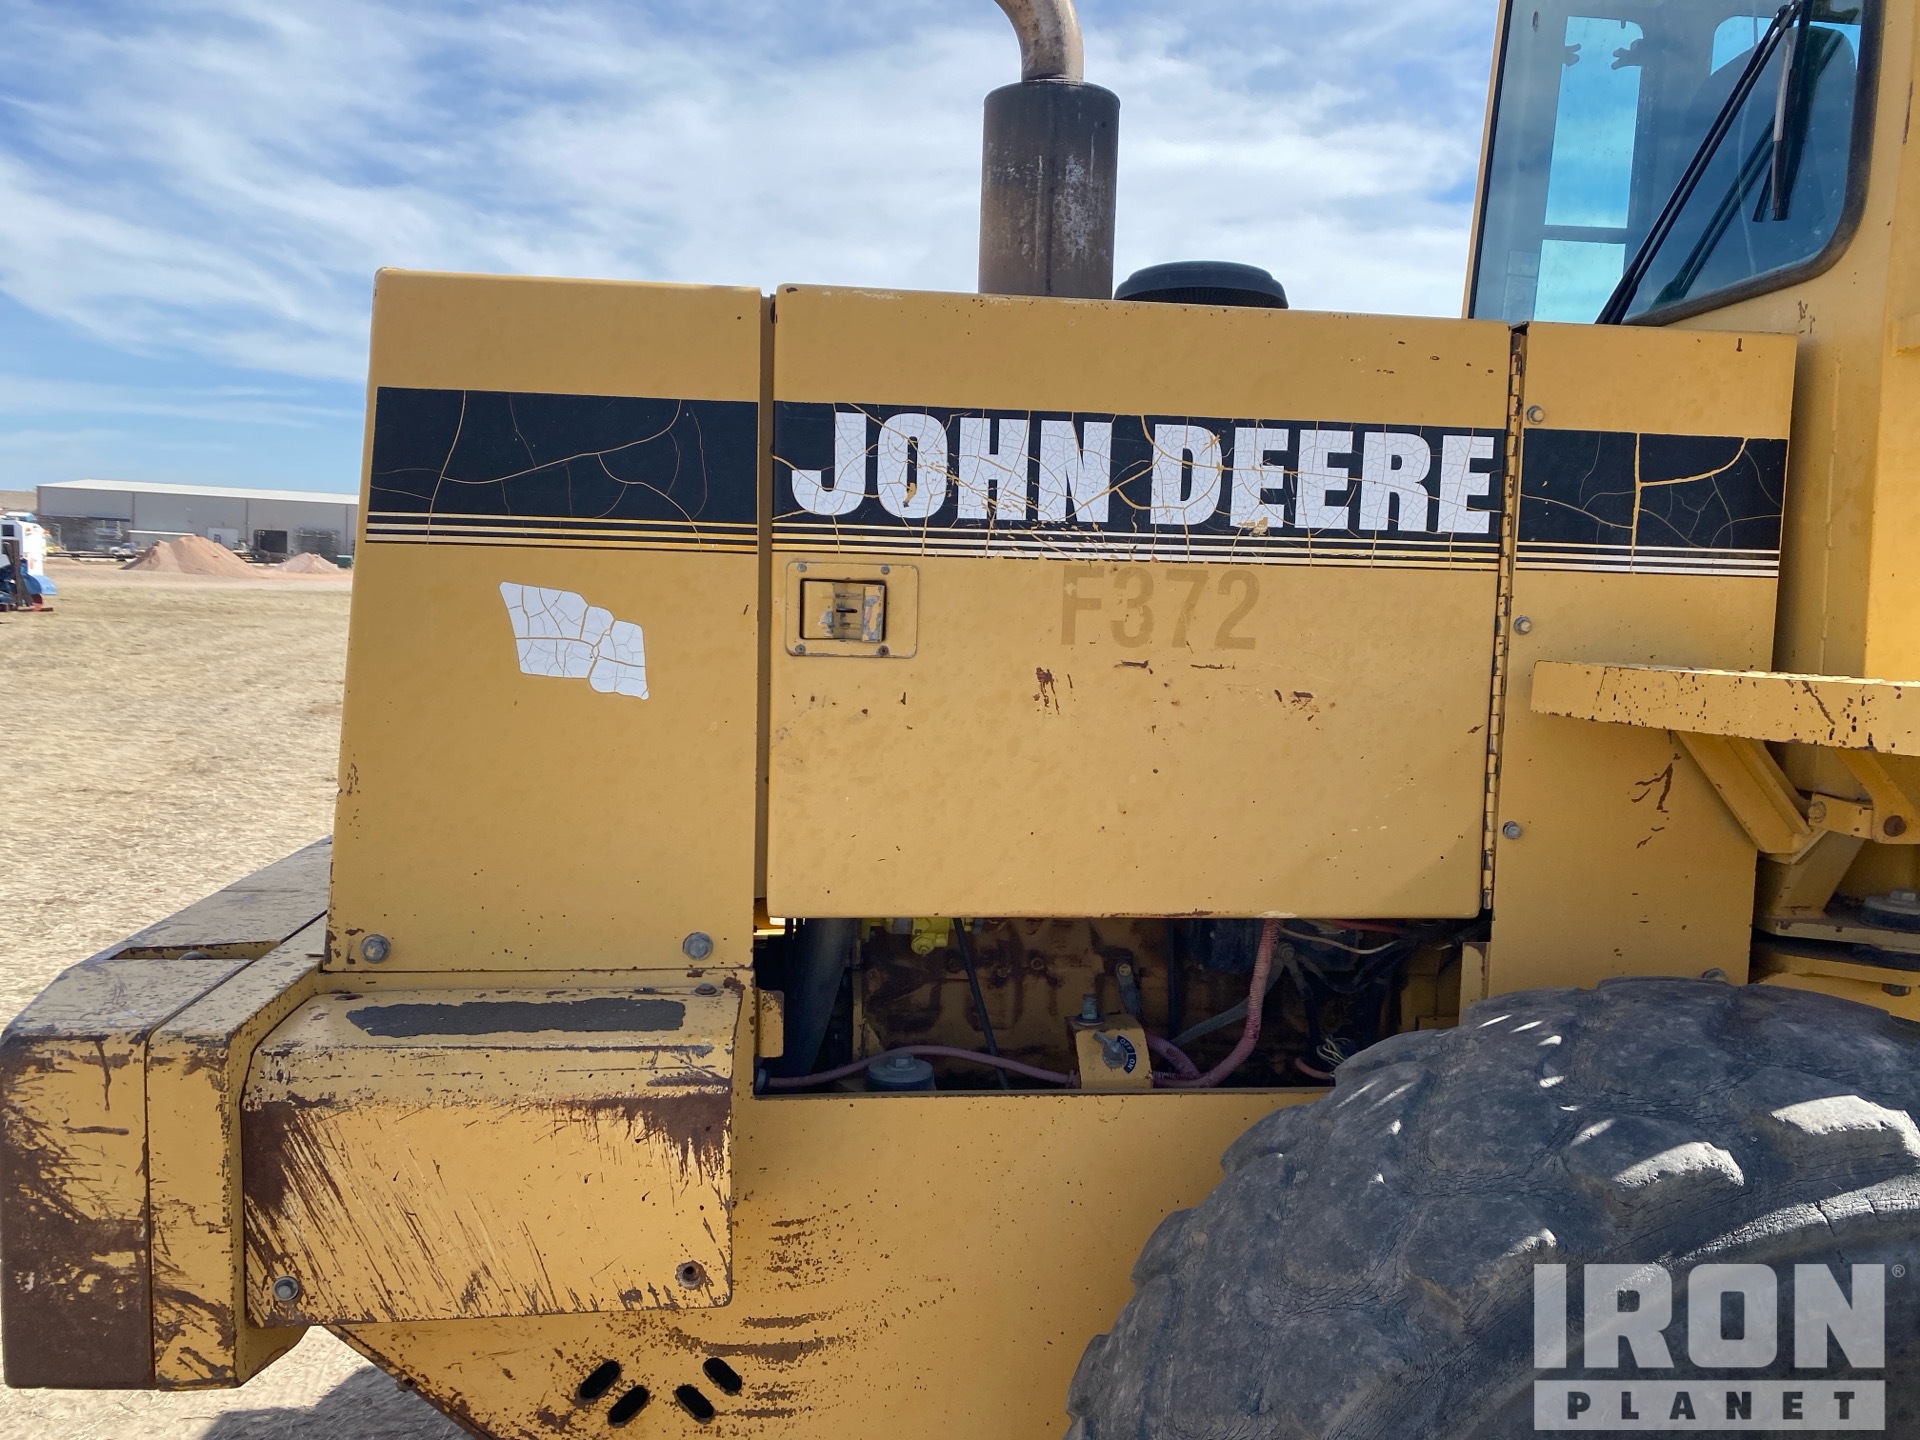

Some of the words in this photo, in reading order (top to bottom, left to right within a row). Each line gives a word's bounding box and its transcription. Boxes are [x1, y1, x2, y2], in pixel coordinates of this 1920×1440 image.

[790, 411, 1113, 524] JOHN
[1150, 422, 1495, 534] DEERE
[1061, 565, 1260, 650] F372
[1119, 1038, 1133, 1051] OFF
[1127, 1058, 1136, 1070] ON
